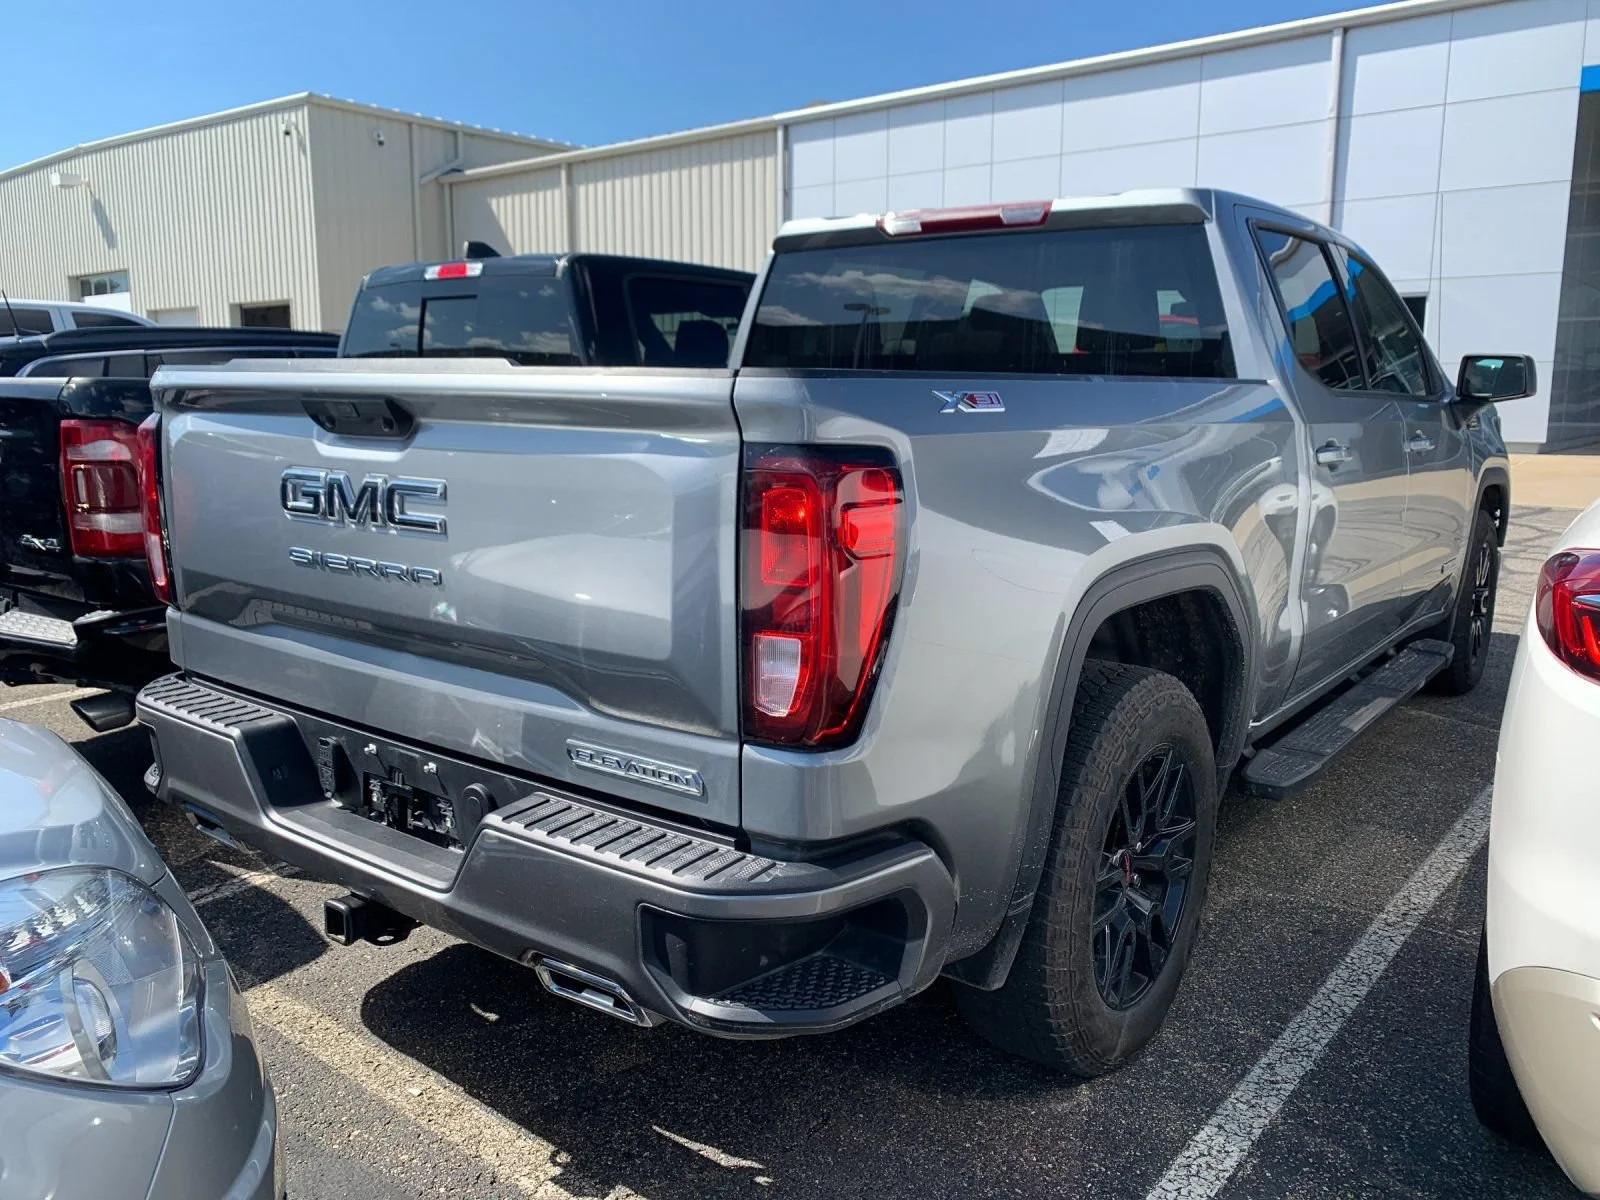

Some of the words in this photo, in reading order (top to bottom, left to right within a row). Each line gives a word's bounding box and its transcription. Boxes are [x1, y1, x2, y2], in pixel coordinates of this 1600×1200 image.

[281, 466, 448, 535] GMC
[289, 546, 443, 586] SIERRA
[575, 748, 693, 786] ELEVATION
